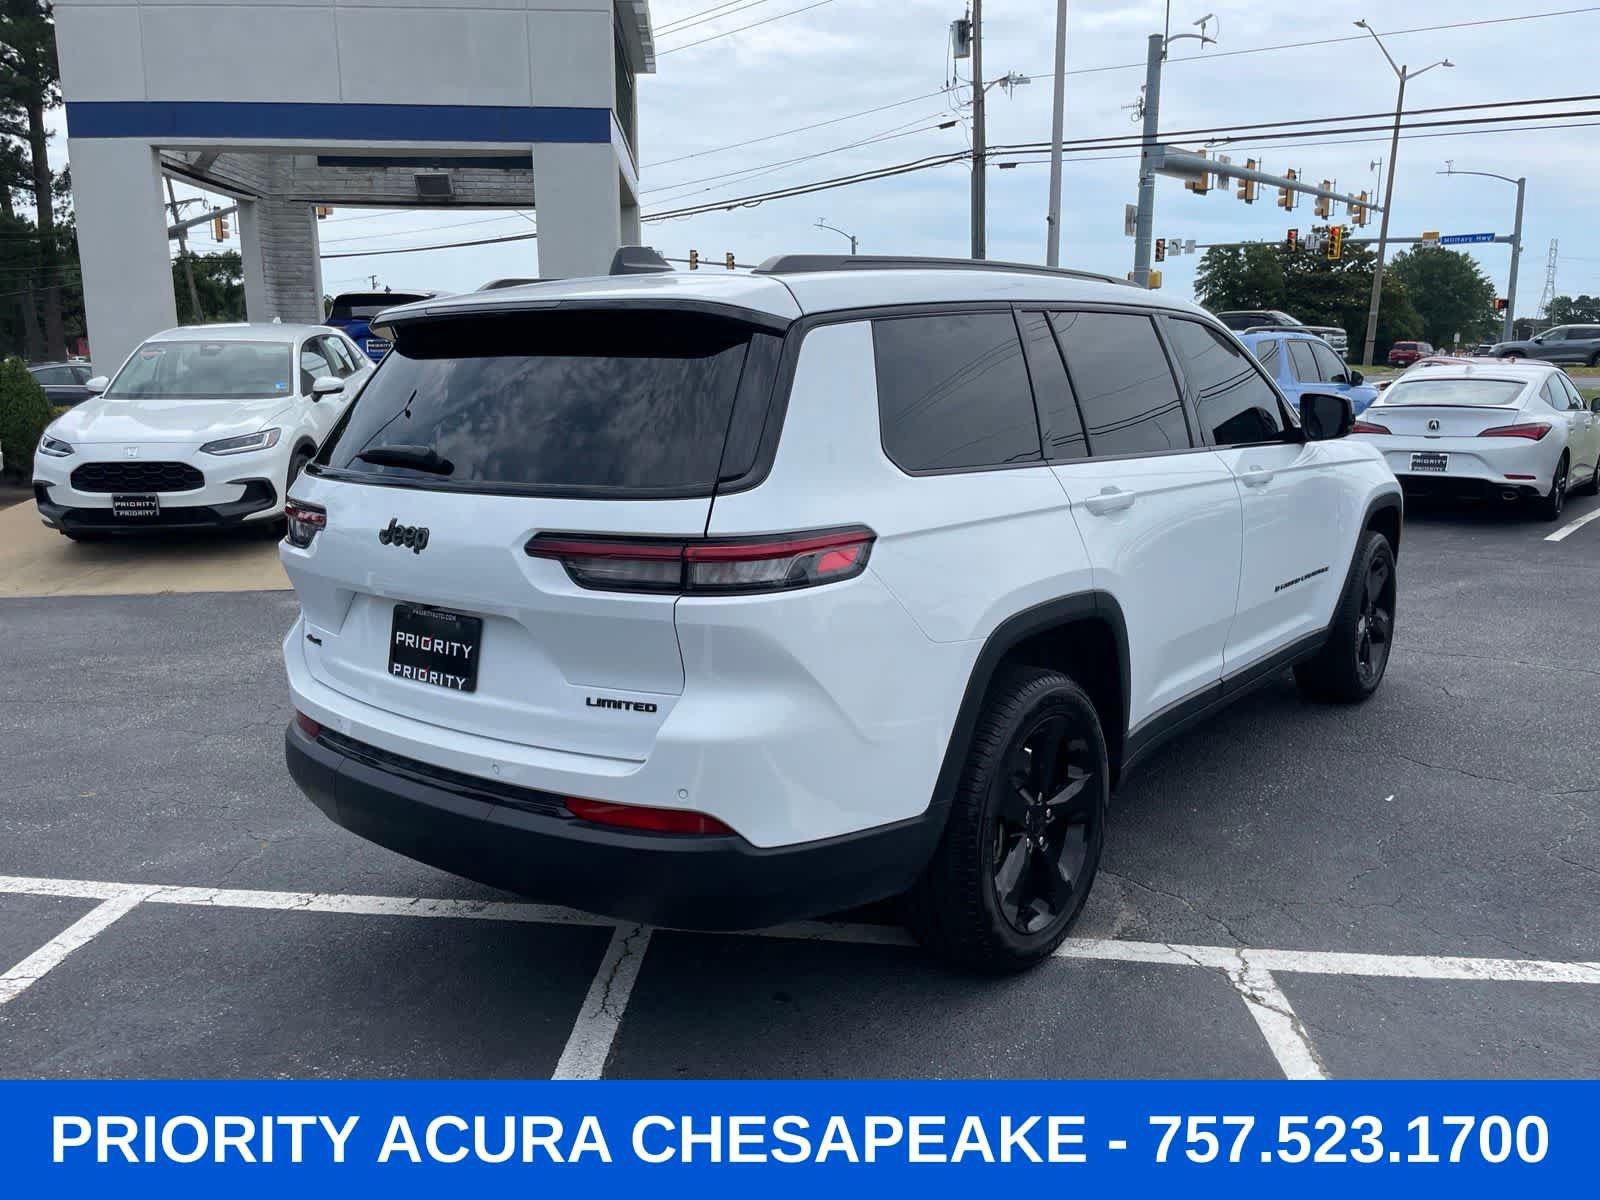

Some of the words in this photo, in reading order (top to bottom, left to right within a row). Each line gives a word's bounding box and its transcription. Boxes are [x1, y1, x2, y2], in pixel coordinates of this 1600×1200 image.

[1443, 236, 1473, 245] Military
[1476, 234, 1492, 242] Hwy
[379, 517, 430, 555] Jeep
[395, 631, 473, 660] PRIORITY
[393, 663, 467, 690] PRIORITY
[585, 695, 658, 713] LIMITED
